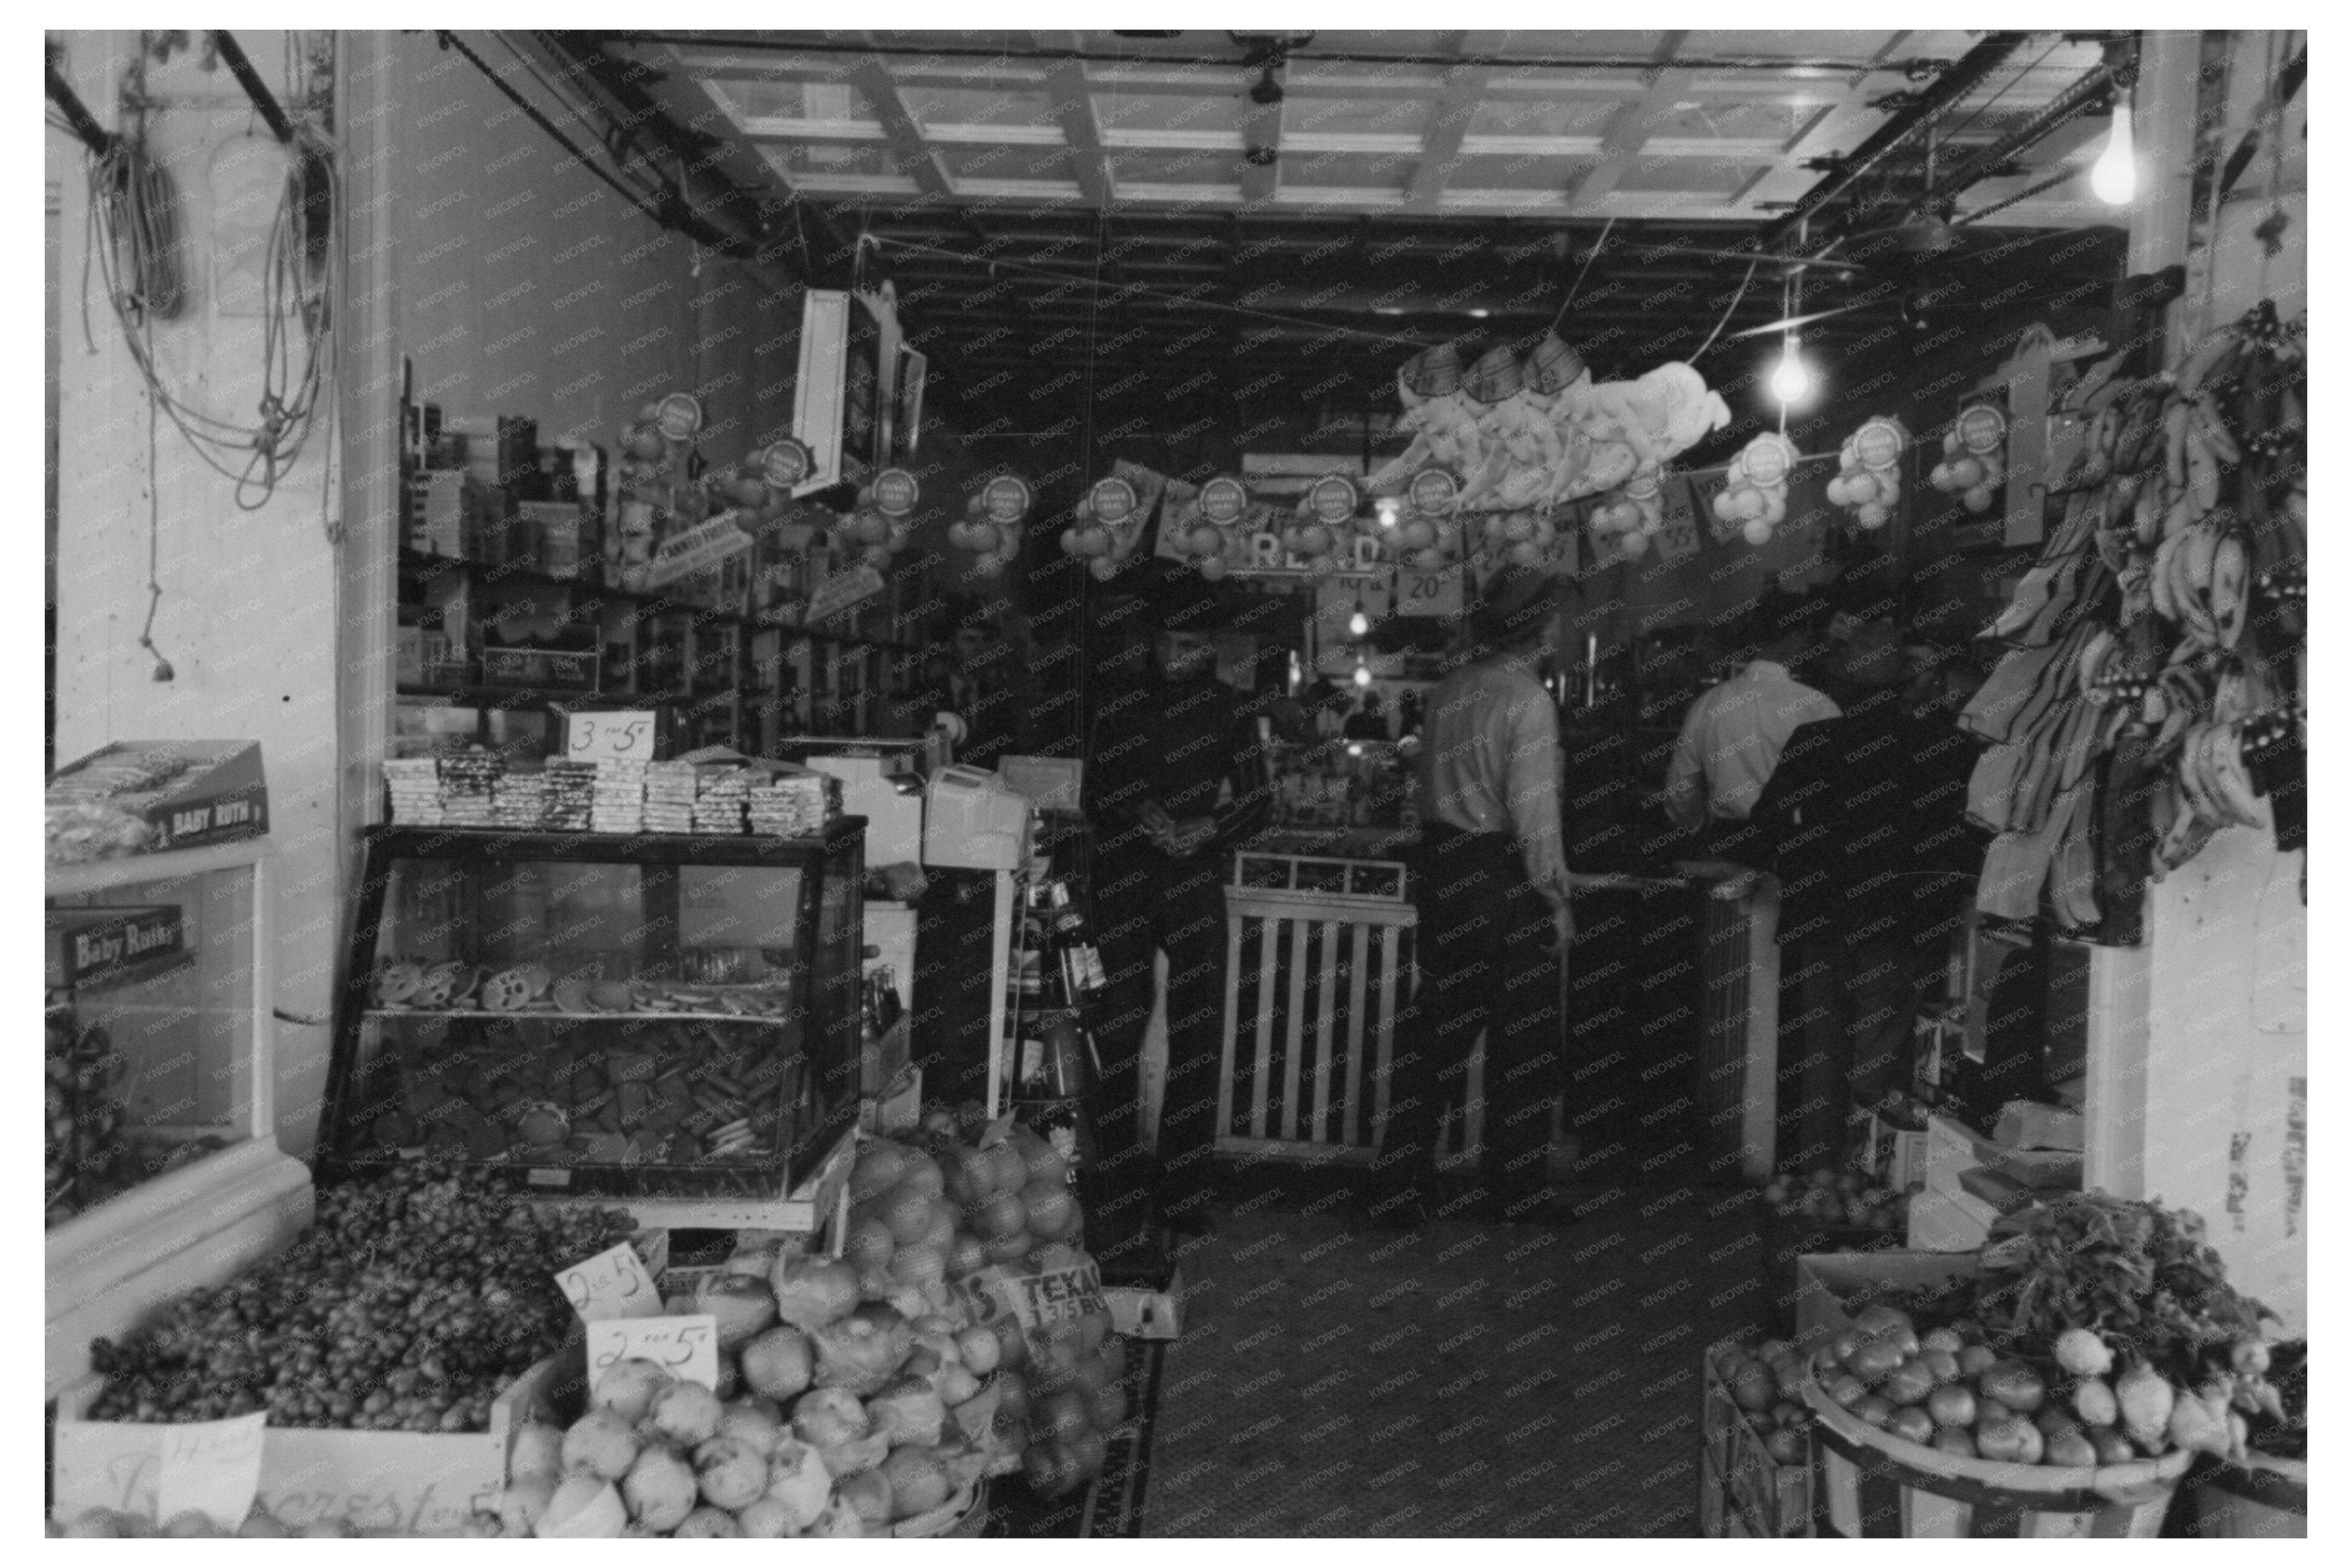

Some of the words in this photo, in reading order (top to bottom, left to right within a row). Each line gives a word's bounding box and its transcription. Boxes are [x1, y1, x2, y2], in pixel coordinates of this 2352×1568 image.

[1209, 492, 1236, 500] SILVER
[1319, 491, 1346, 500] SILVER
[571, 720, 595, 751] 3
[173, 807, 211, 834] BABY
[215, 800, 249, 826] RUTH
[76, 933, 123, 969] Baby
